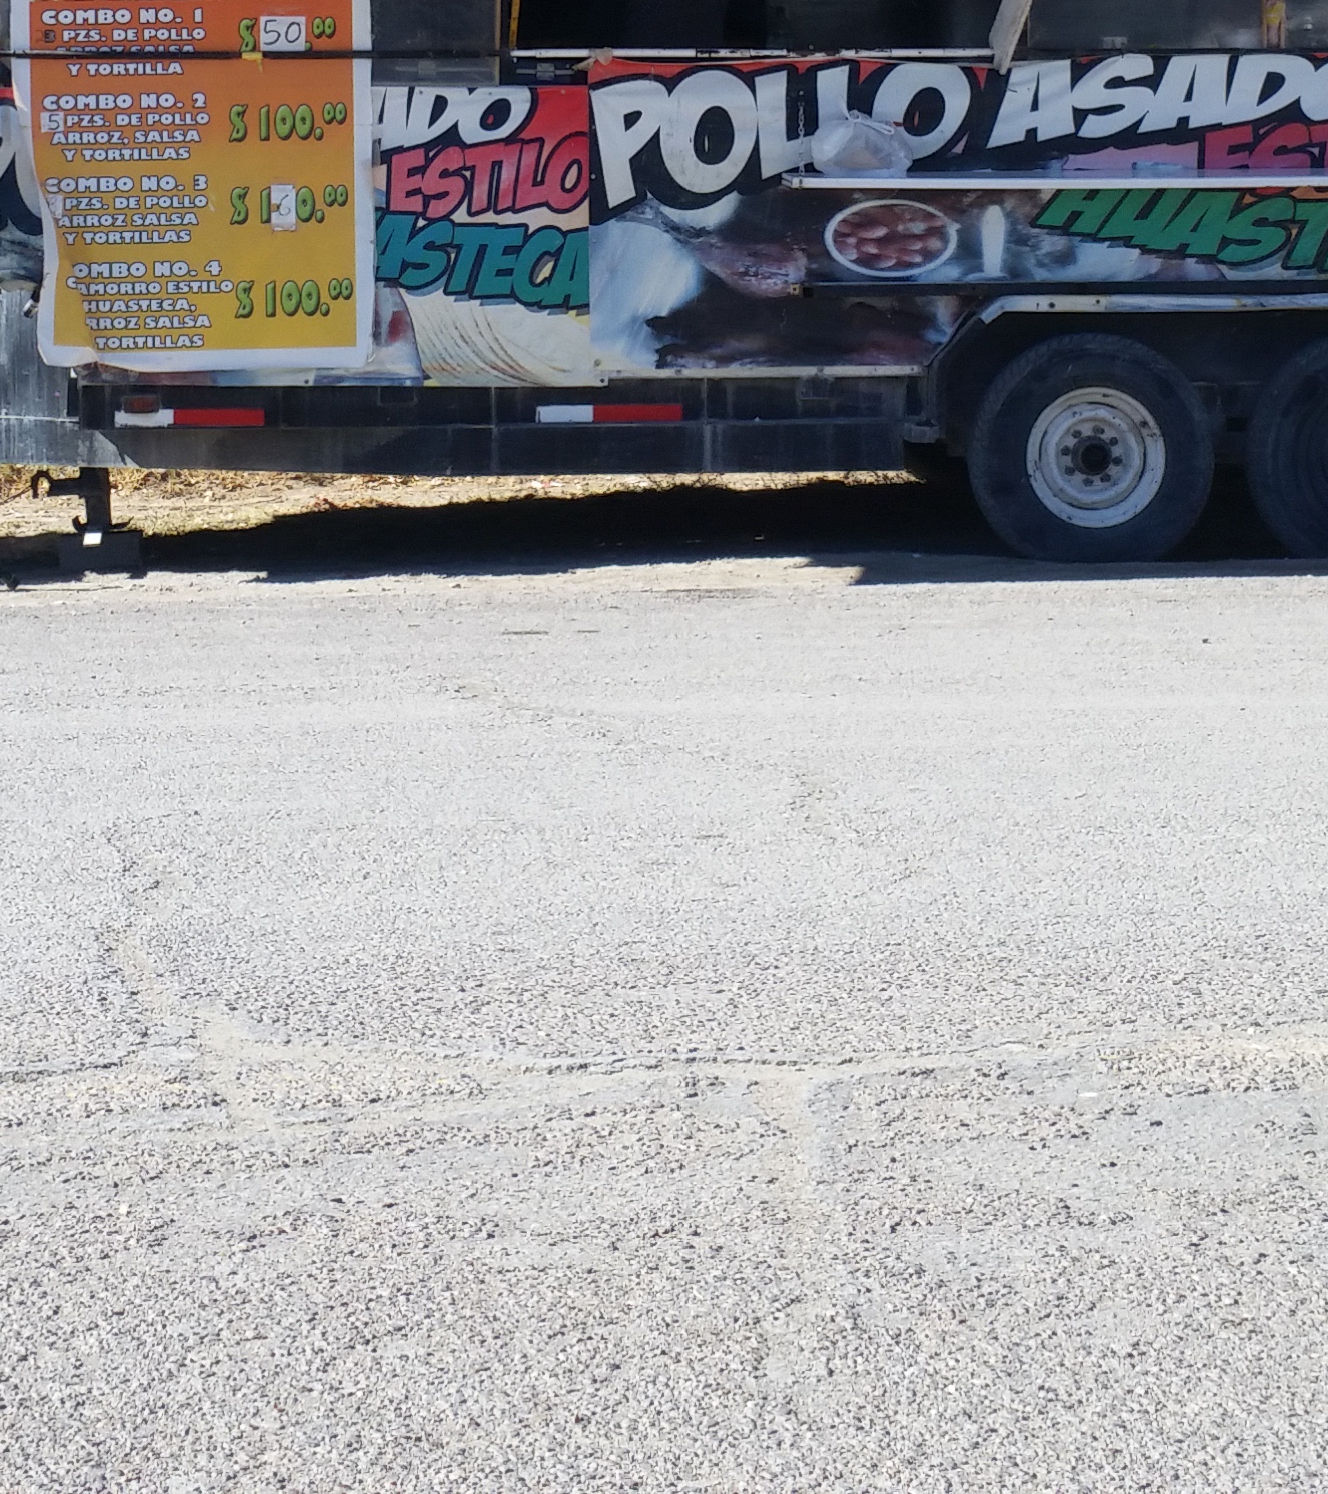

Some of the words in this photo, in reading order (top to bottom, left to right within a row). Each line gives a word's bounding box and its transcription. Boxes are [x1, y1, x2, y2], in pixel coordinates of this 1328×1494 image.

[41, 8, 132, 25] COMBO
[139, 7, 183, 24] NO.
[193, 7, 203, 23] 1
[62, 28, 107, 43] PZS.
[112, 28, 138, 42] DE
[143, 27, 206, 41] POLLO
[66, 63, 82, 76] Y
[86, 62, 184, 76] TORTILLA
[42, 93, 133, 111] COMBO
[140, 93, 184, 109] NO.
[192, 92, 207, 108] 2
[47, 113, 60, 130] 5
[65, 113, 111, 127] PZS.
[116, 113, 142, 126] DE
[146, 112, 210, 126] POLLO
[51, 130, 130, 145] ARROZ,
[133, 129, 201, 143] SALSA
[591, 61, 972, 209] POLLO
[62, 148, 77, 162] Y
[81, 147, 191, 161] TORTILLAS
[45, 176, 134, 193] COMBO
[141, 175, 185, 191] NO.
[193, 174, 208, 191] 3
[389, 135, 589, 219] ESTILO
[64, 196, 109, 211] PZS.
[114, 195, 140, 209] DE
[145, 195, 208, 209] POLLO
[58, 213, 127, 228] ARROZ
[131, 212, 199, 226] SALSA
[62, 231, 79, 245] Y
[82, 230, 191, 245] TORTILLAS
[72, 261, 147, 279] OMBO
[153, 261, 198, 278] NO.
[204, 260, 222, 276] 4
[166, 280, 234, 294] ESTILO
[82, 298, 197, 313] HUASTECA,
[144, 314, 212, 329] SALSA
[94, 334, 204, 350] TORTILLAS
